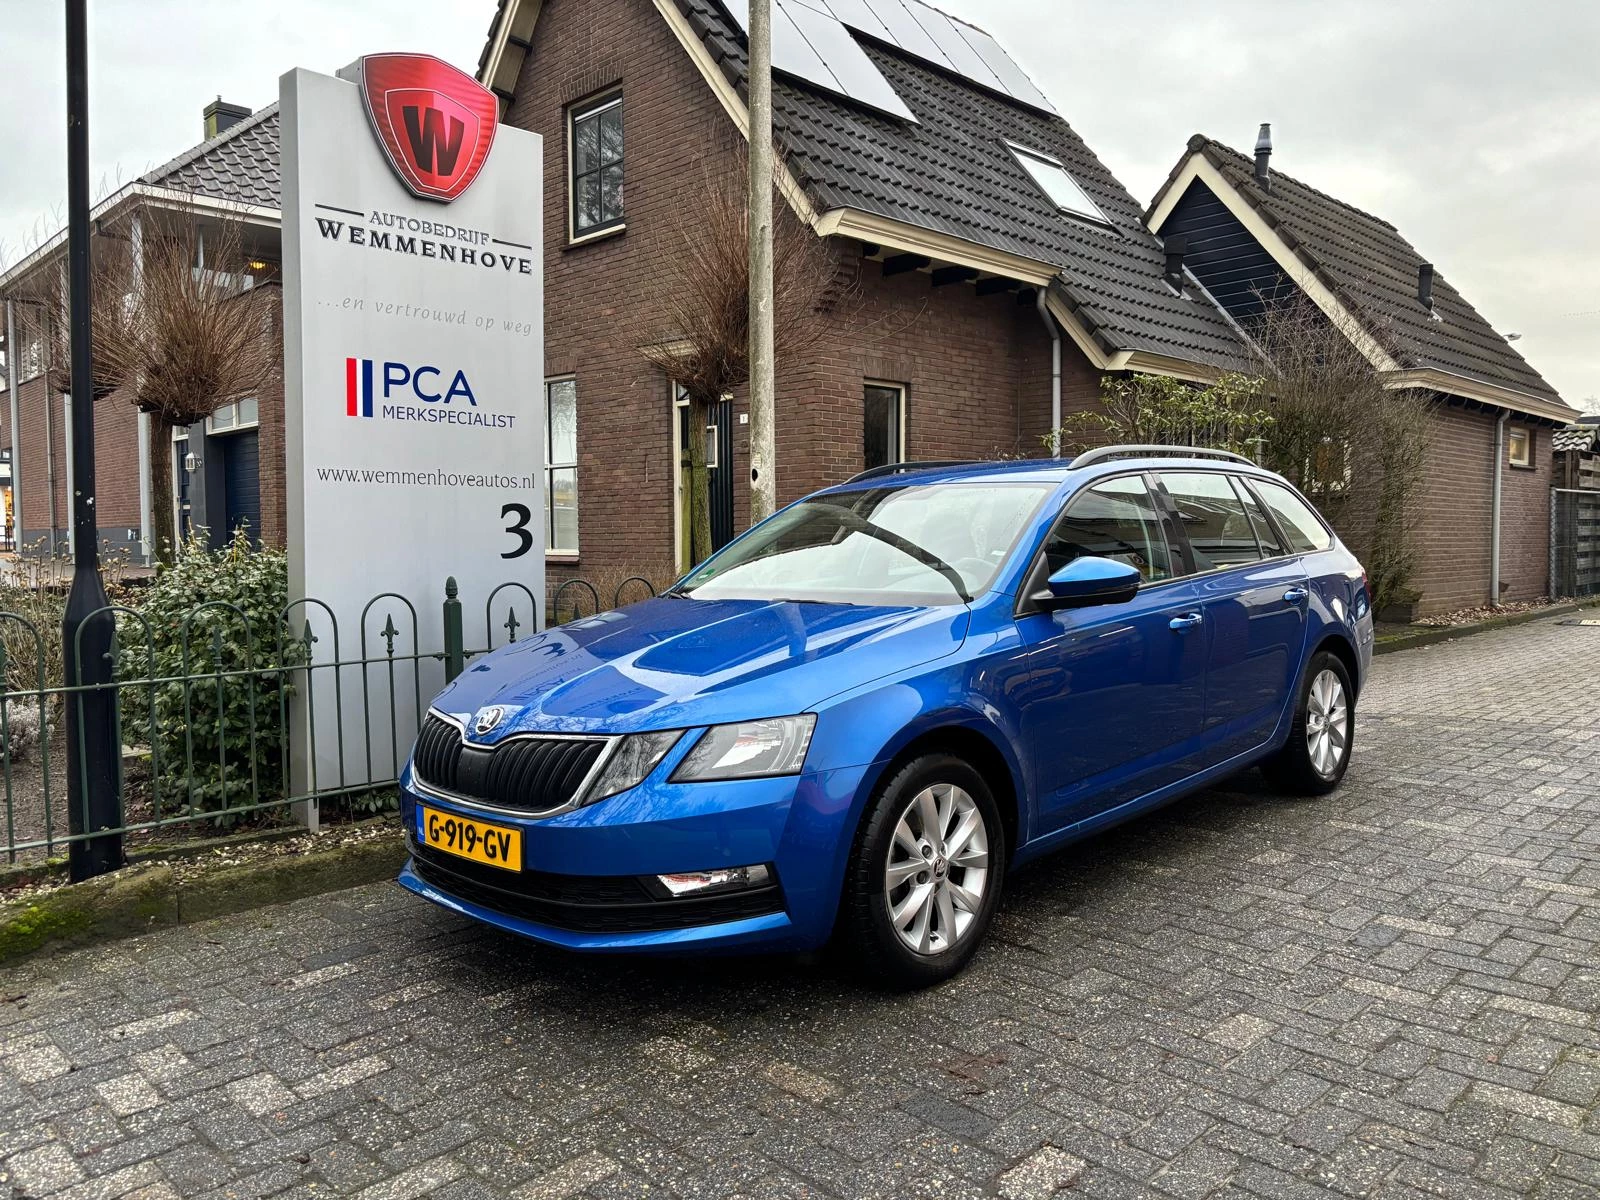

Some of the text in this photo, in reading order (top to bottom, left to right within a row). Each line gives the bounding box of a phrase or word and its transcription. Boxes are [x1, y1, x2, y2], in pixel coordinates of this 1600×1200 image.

[402, 105, 465, 177] W
[315, 217, 533, 275] WEMMENHOVE
[369, 210, 490, 246] AUTOBEDRIJF
[375, 301, 466, 325] vertrouwd
[475, 316, 495, 332] op
[503, 320, 532, 337] weg
[383, 361, 478, 407] PCA
[382, 405, 516, 429] MERKSPECIALIST
[316, 467, 536, 489] www.wemmenhoveautos.nl
[500, 502, 534, 559] 3
[429, 814, 511, 862] G-919-GV
